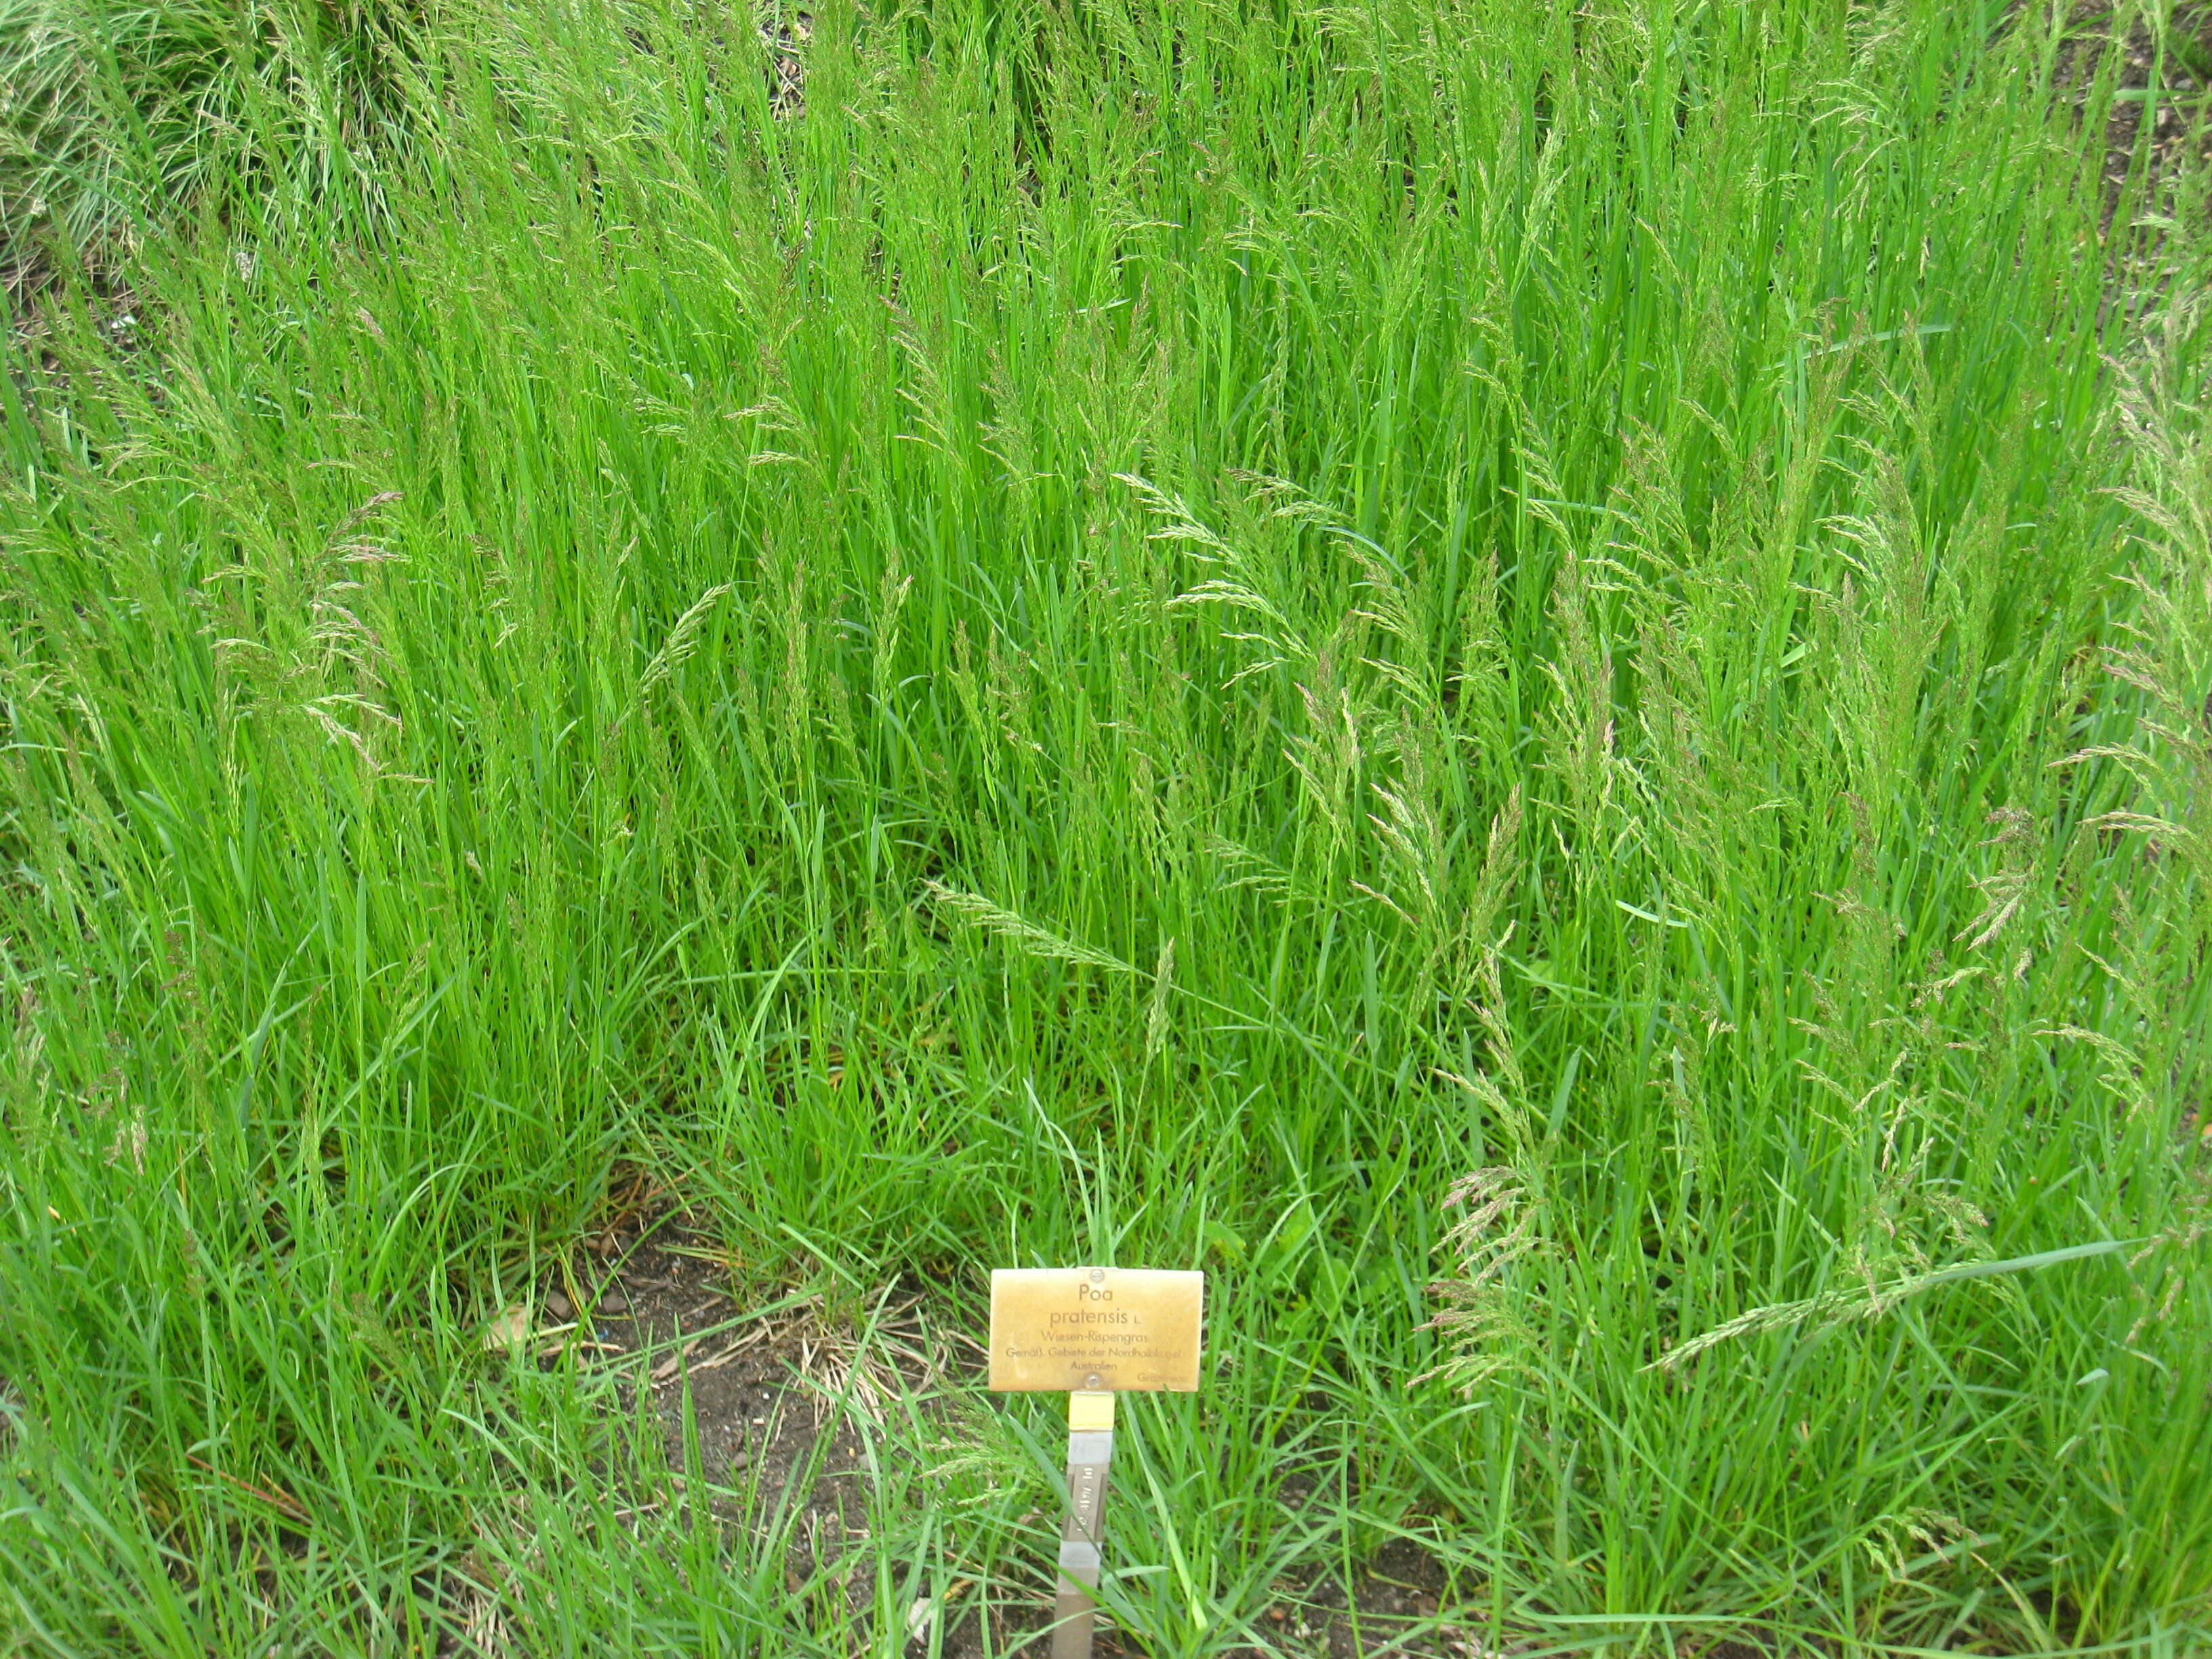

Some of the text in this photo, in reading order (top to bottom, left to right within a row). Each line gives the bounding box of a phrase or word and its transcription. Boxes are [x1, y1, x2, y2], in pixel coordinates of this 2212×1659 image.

[1078, 1284, 1113, 1301] Poa
[1050, 1307, 1128, 1328] pratensis
[1041, 1330, 1149, 1345] Wiesen-Rispengras
[1089, 1347, 1106, 1357] der
[1070, 1361, 1117, 1370] Australien
